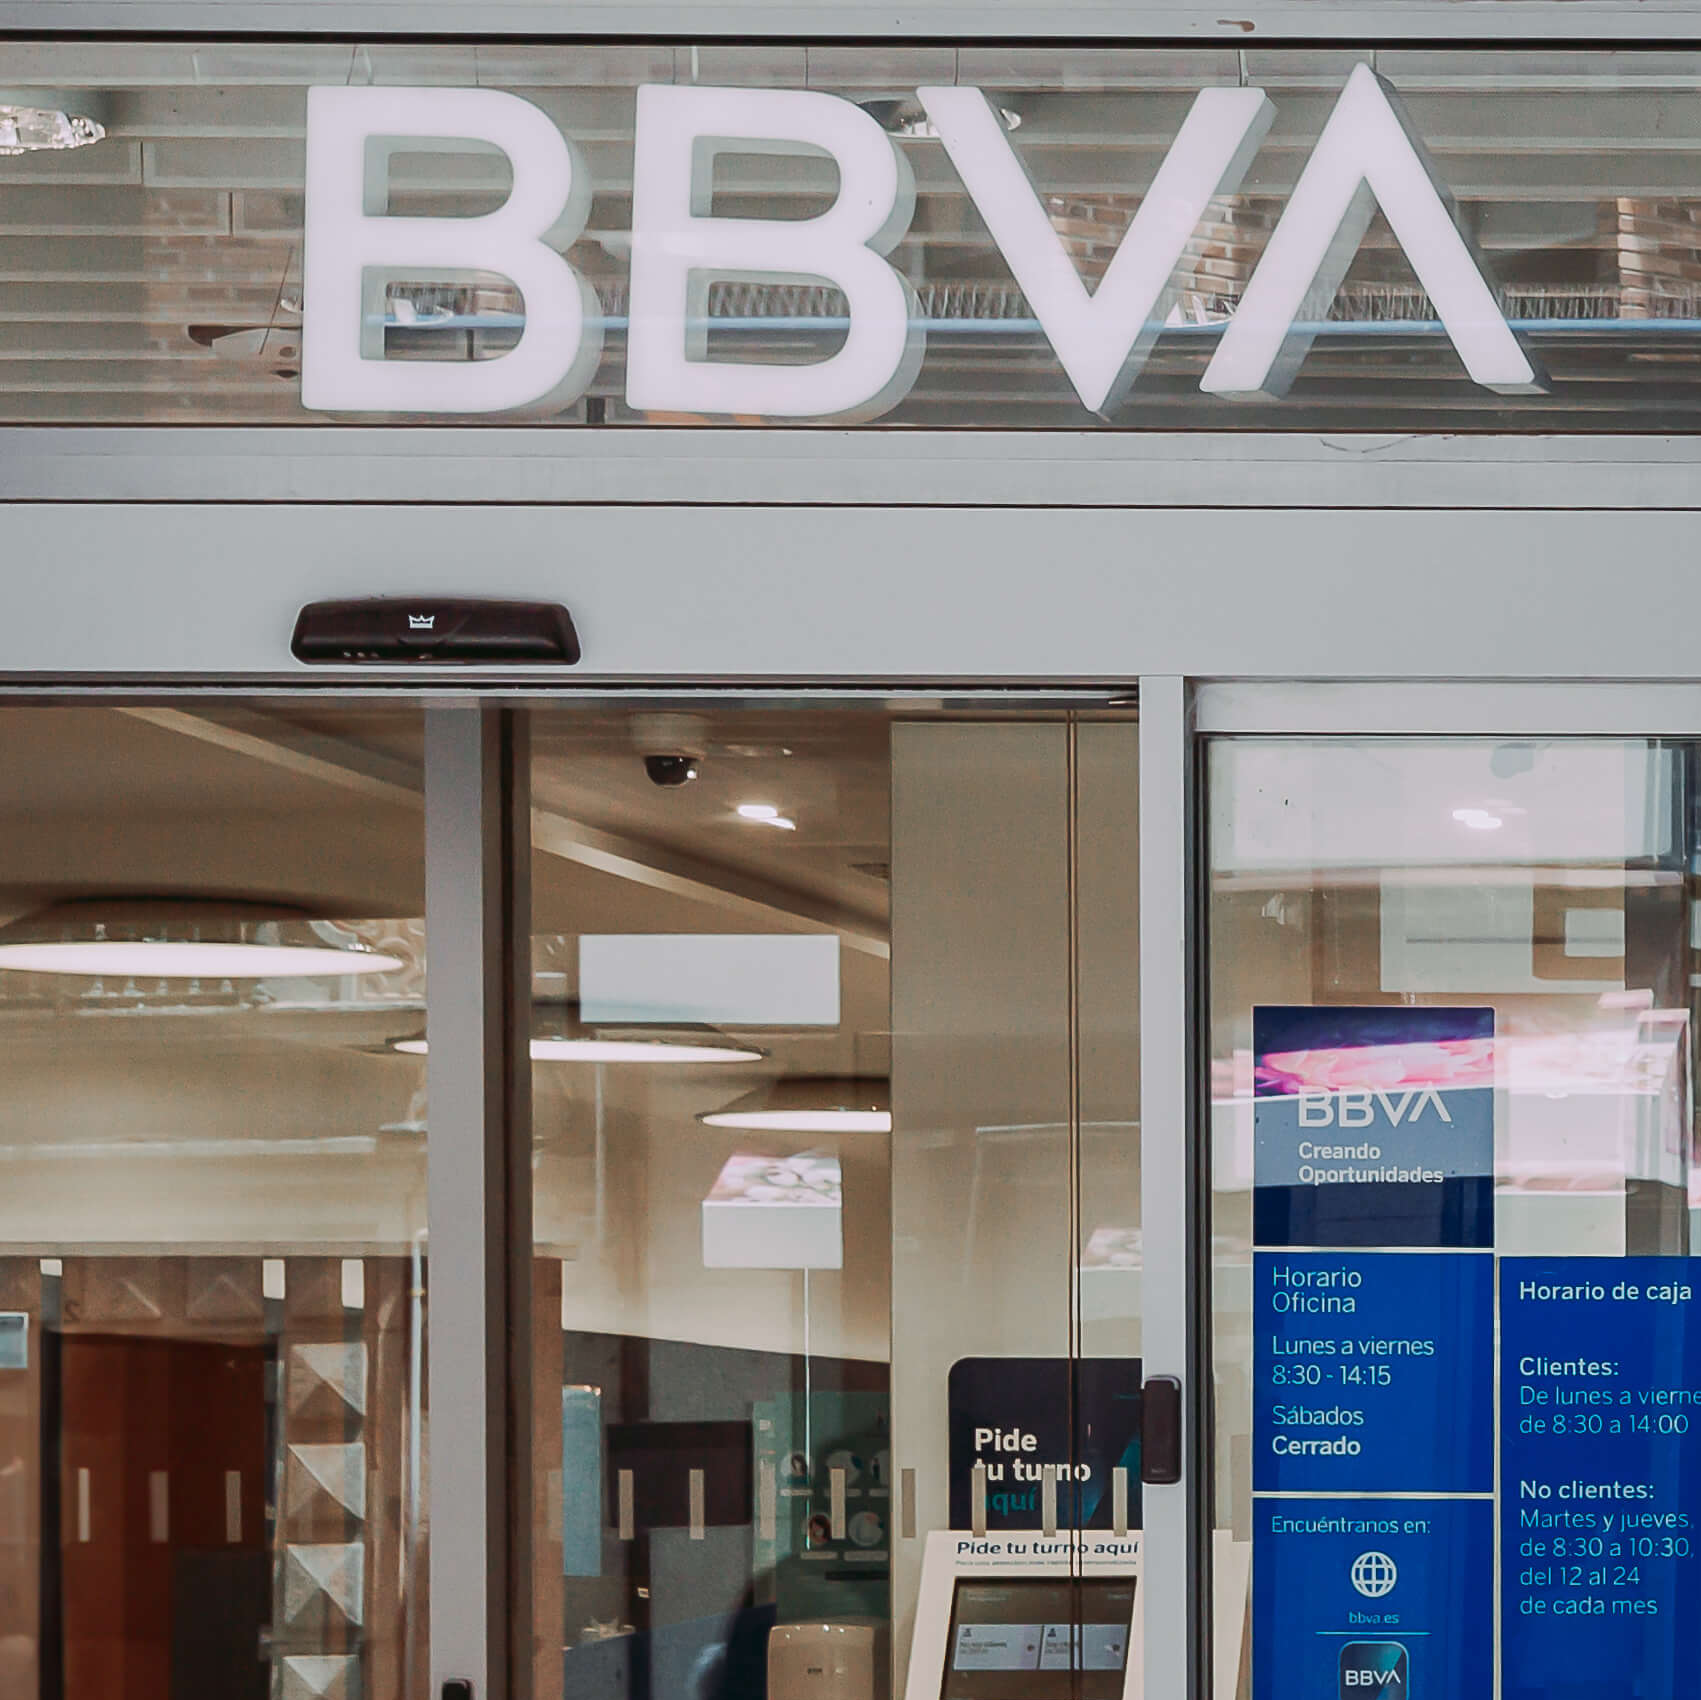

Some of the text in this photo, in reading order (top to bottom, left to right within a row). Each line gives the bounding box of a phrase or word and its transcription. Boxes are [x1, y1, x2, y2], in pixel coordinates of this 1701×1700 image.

[302, 60, 1545, 420] BBVA
[1298, 1082, 1452, 1128] BBVA
[1299, 1142, 1381, 1160] Creando
[1299, 1165, 1444, 1185] Oportunidades
[1273, 1266, 1362, 1287] Horario
[1272, 1291, 1356, 1313] Oficina
[1519, 1281, 1692, 1304] Horario de caja
[1273, 1335, 1435, 1355] Lunes a viernes
[1272, 1364, 1321, 1385] 8:30
[1339, 1365, 1391, 1386] 14:15
[1519, 1356, 1619, 1376] Clientes:
[1520, 1386, 1549, 1405] De
[1555, 1386, 1613, 1405] lunes
[1619, 1391, 1631, 1405] a
[1272, 1406, 1364, 1426] Sábados
[1519, 1414, 1689, 1434] de 8:30 a 14:00
[975, 1427, 1038, 1452] Pide
[1272, 1435, 1361, 1455] Cerrado
[1520, 1480, 1654, 1499] No clientes:
[985, 1487, 1037, 1517] quí
[1272, 1516, 1431, 1534] Encuéntranos en:
[1520, 1509, 1596, 1528] Martes
[1602, 1514, 1614, 1533] y
[957, 1540, 1139, 1556] Pide tu turno aquí
[1519, 1538, 1546, 1557] de
[1552, 1537, 1603, 1557] 8:30
[1609, 1543, 1622, 1557] a
[1520, 1567, 1641, 1586] del 12 al 24
[1519, 1596, 1658, 1615] de cada mes
[1349, 1612, 1399, 1625] bbva.es
[1345, 1669, 1401, 1686] BBVA
